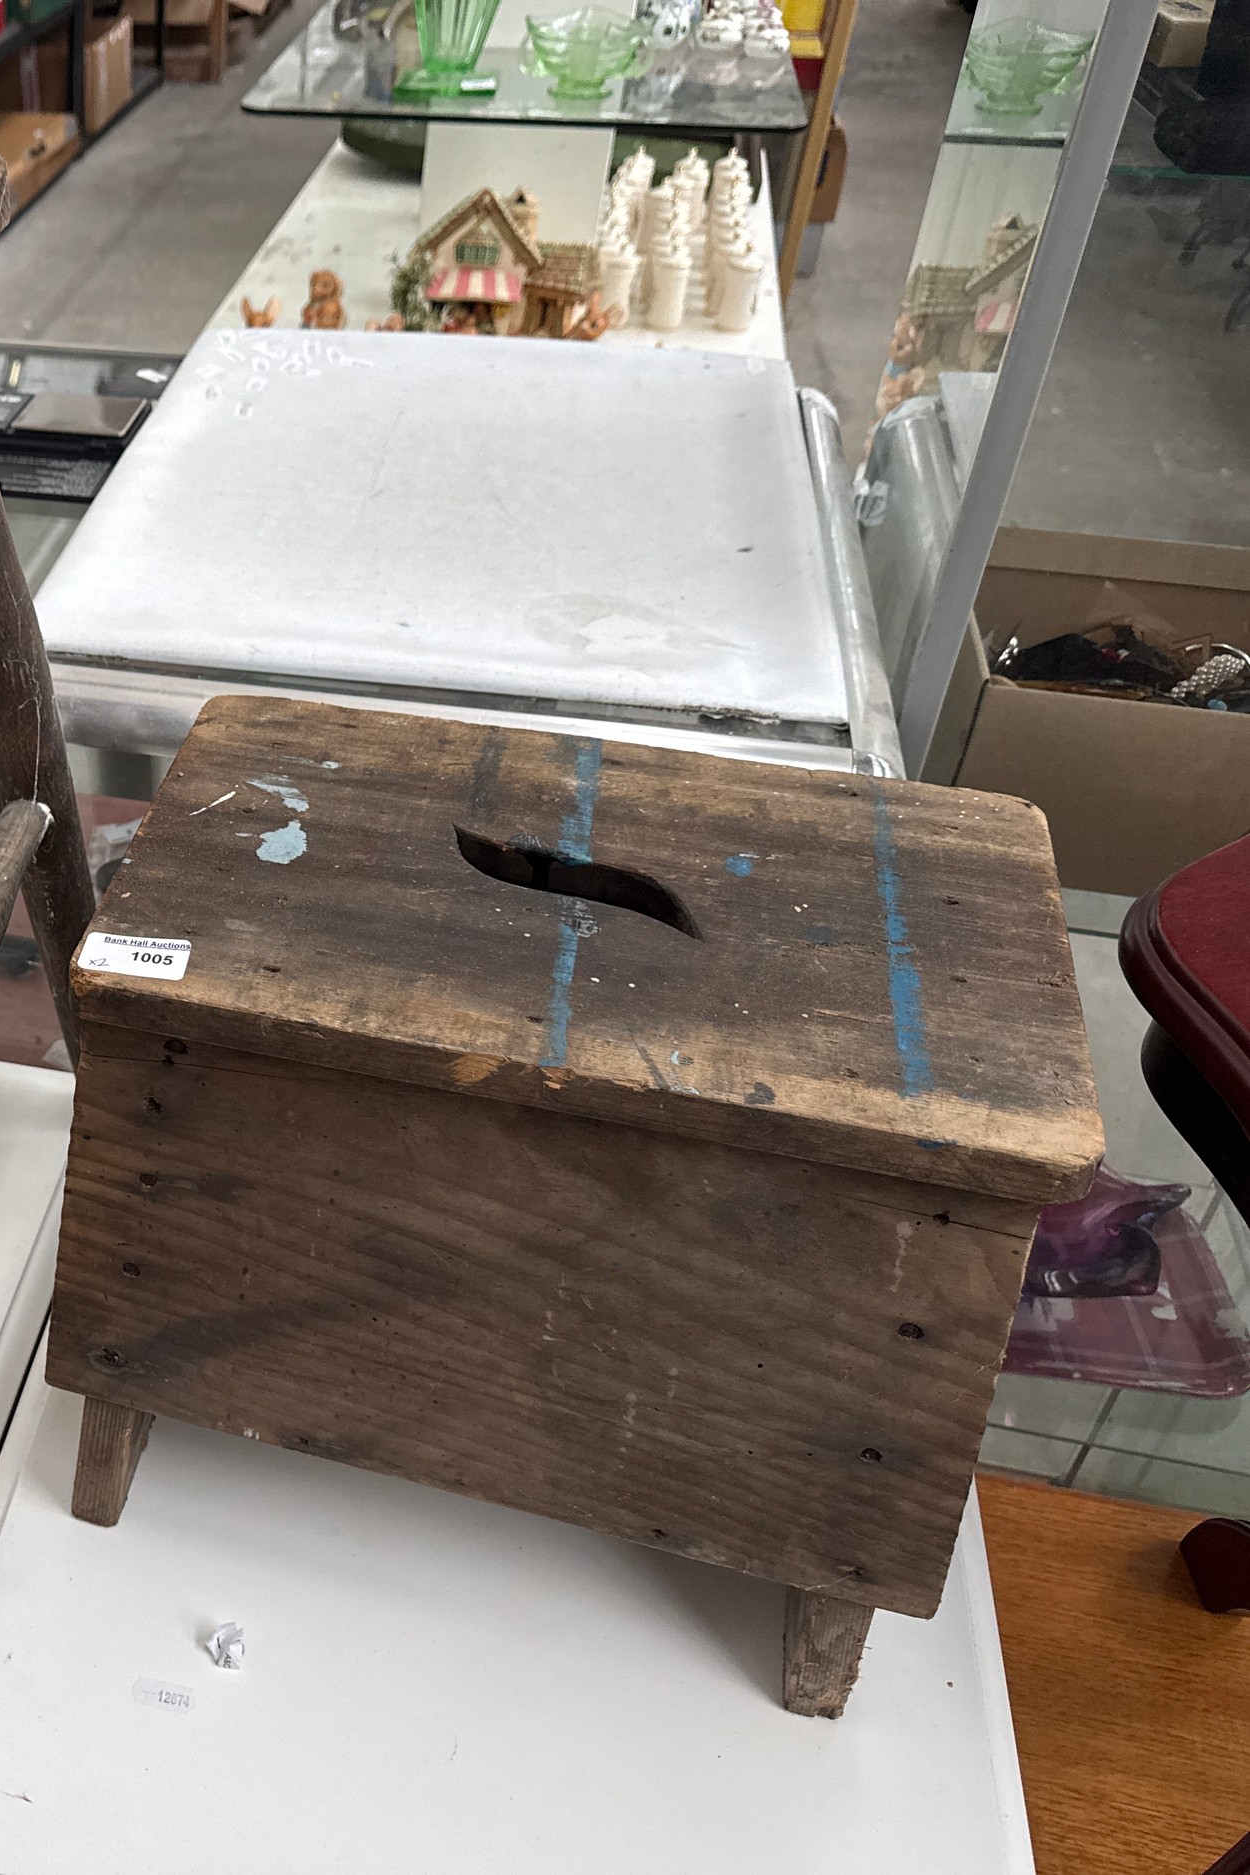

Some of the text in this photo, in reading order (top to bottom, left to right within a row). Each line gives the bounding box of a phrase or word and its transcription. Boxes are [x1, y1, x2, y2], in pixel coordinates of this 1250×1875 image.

[104, 936, 191, 950] Bank Hall Auctions
[131, 951, 174, 966] 1005
